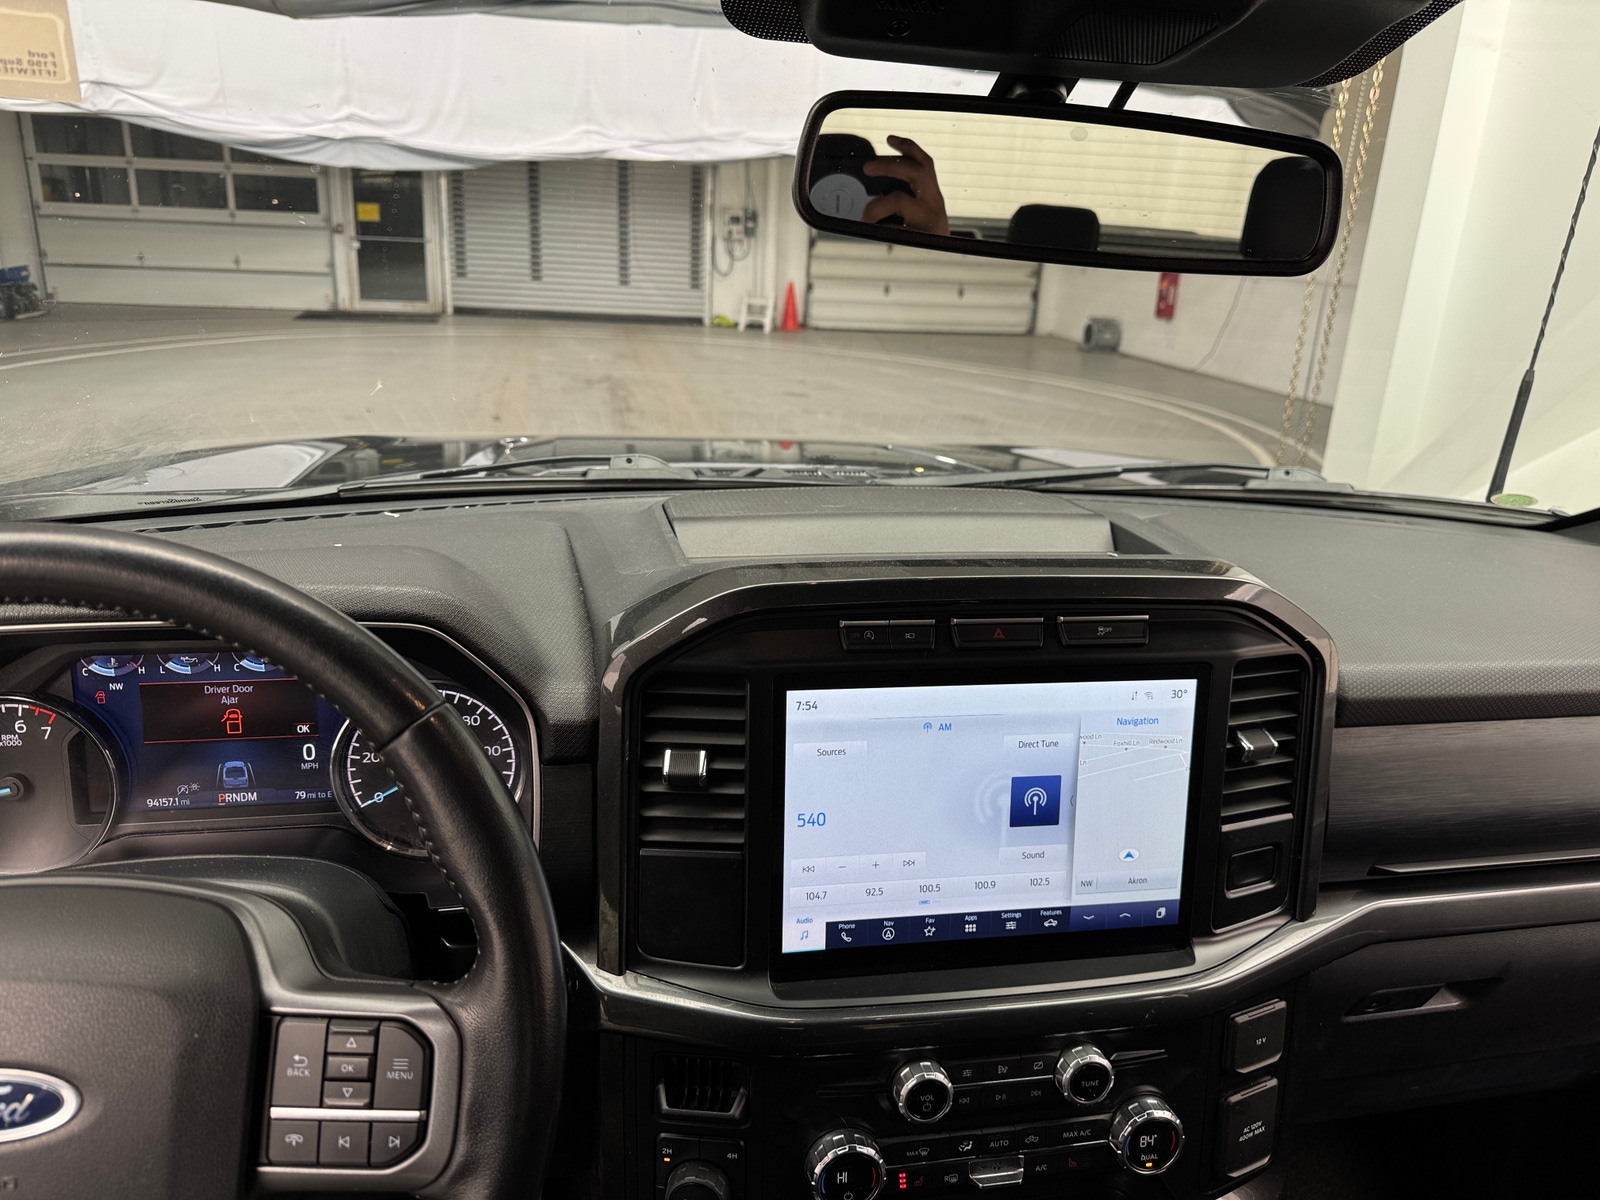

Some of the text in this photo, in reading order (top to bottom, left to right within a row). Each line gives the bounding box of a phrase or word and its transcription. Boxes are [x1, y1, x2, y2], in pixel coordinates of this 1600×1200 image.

[82, 667, 89, 676] C
[138, 666, 146, 675] H
[213, 663, 221, 672] H
[233, 663, 241, 672] C
[109, 682, 124, 691] NW
[204, 684, 254, 695] Driver Door
[1171, 689, 1188, 699] 30°
[221, 695, 239, 706] Ajar
[796, 700, 818, 711] 7:54
[14, 719, 27, 733] 6
[1116, 716, 1159, 727] Navigation
[296, 724, 310, 733] OK
[938, 722, 952, 732] AM
[41, 726, 52, 740] 7
[1018, 739, 1059, 749] Direct Tune
[302, 743, 316, 761] 0
[816, 748, 847, 757] Sources
[301, 762, 319, 770] MPH
[217, 791, 258, 803] PRNDM
[295, 790, 306, 800] 79
[307, 790, 317, 799] mi
[318, 789, 327, 799] to
[146, 797, 190, 808] 94157.1 mi
[797, 812, 827, 828] 540
[1021, 850, 1045, 860] Sound
[974, 880, 996, 890] 100.9
[1029, 877, 1050, 887] 102.5
[1080, 879, 1094, 888] NW
[1127, 876, 1148, 885] Akron
[865, 887, 884, 897] 92.5
[919, 884, 941, 893] 100.5
[805, 891, 828, 901] 104.7
[1001, 911, 1022, 920] Settings
[1040, 909, 1062, 917] Features
[796, 917, 814, 925] Audio
[964, 914, 978, 922] Apps
[838, 922, 856, 930] Phone
[286, 1067, 311, 1077] BACK
[341, 1064, 354, 1073] OK
[386, 1071, 414, 1080] MENU
[1081, 1079, 1100, 1088] TUNE
[920, 1094, 935, 1102] VOL
[1243, 1125, 1251, 1134] AC
[1254, 1125, 1266, 1136] MAX
[1062, 1129, 1092, 1140] MAX A/C
[989, 1139, 1010, 1149] AUTO
[661, 1147, 673, 1155] 2H
[906, 1150, 919, 1158] MAX
[726, 1152, 738, 1160] 4H
[1140, 1153, 1159, 1162] DUAL
[1035, 1163, 1048, 1172] A/C
[836, 1171, 848, 1184] HI
